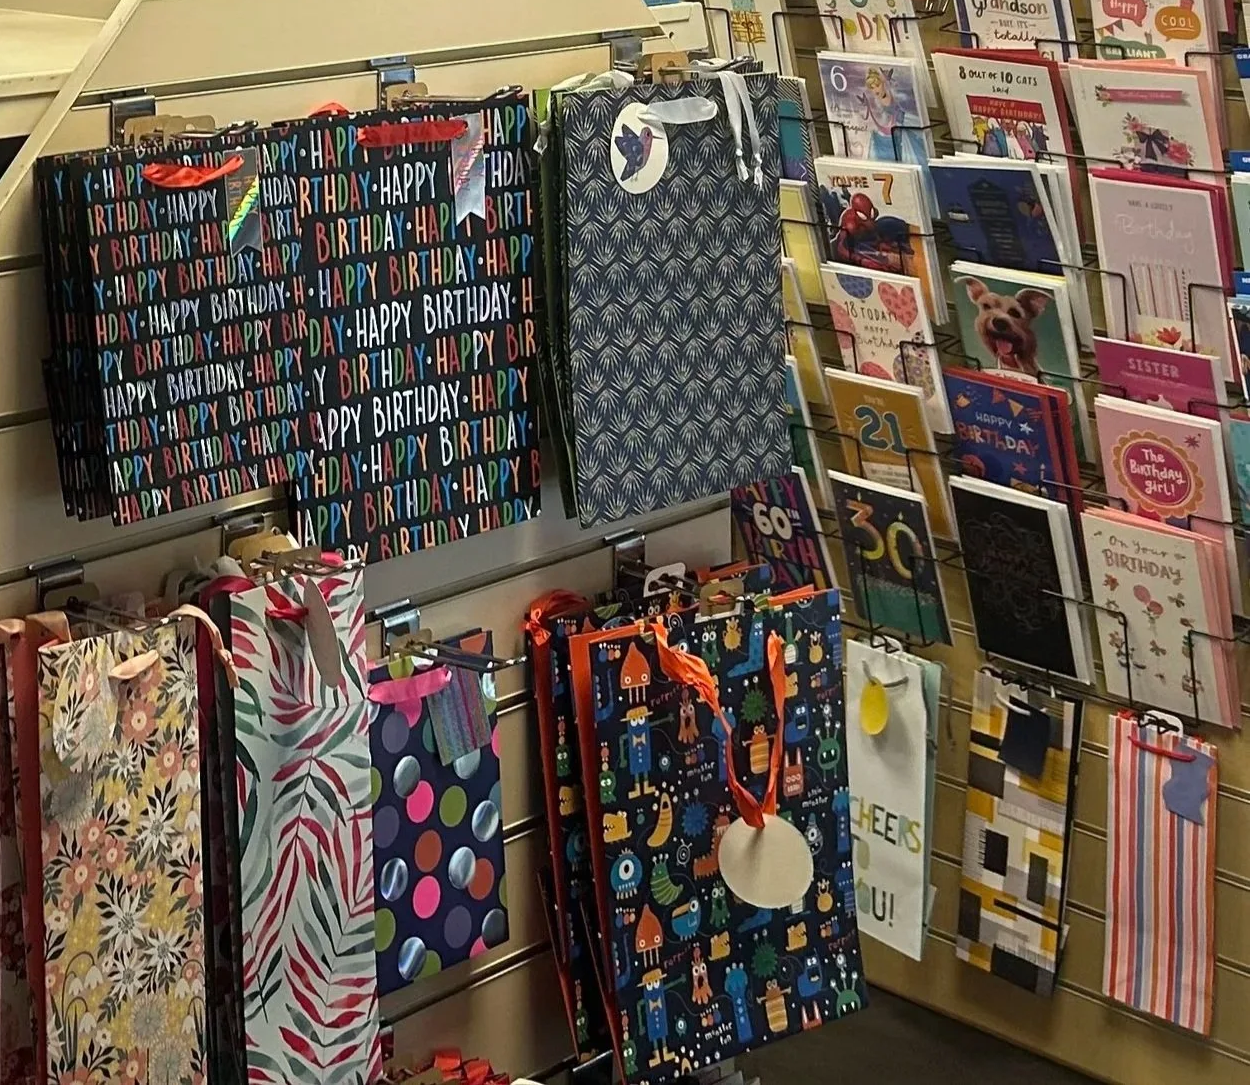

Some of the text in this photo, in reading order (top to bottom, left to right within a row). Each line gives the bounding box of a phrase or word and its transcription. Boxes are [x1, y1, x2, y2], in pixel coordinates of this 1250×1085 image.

[994, 28, 1038, 42] totally
[1160, 15, 1195, 28] COOL
[830, 65, 848, 92] 6
[958, 65, 967, 80] 8
[1000, 67, 1013, 83] 10
[380, 161, 438, 205] HAPPY
[828, 173, 894, 206] YOU'RE 7
[166, 188, 218, 225] HAPPY
[111, 227, 192, 270] BIRTHDAY
[315, 210, 406, 263] BIRTHDAY
[114, 253, 255, 309] HAPPY BIRTHDAY
[318, 244, 477, 308] HAPPY BIRTHDAY
[149, 281, 285, 335] HAPPY BIRTHDAY
[355, 281, 511, 349] HAPPY BIRTHDAY
[844, 300, 858, 320] 18
[133, 318, 272, 376] BIRTHDAY HAPPY
[339, 329, 495, 401] BIRTHDAY HAPPY
[1127, 358, 1180, 379] SISTER
[103, 359, 245, 418] HAPPY BIRTHDAY
[372, 366, 529, 438] BIRTHDAY HAPPY
[854, 404, 907, 454] 21
[975, 411, 1014, 429] HAPPY
[371, 410, 528, 483] HAPPY BIRTHDAY
[1142, 447, 1166, 463] The
[846, 498, 924, 579] 30
[1109, 535, 1128, 549] On
[1103, 548, 1184, 583] BIRTHDAY
[849, 795, 922, 854] CHEERS
